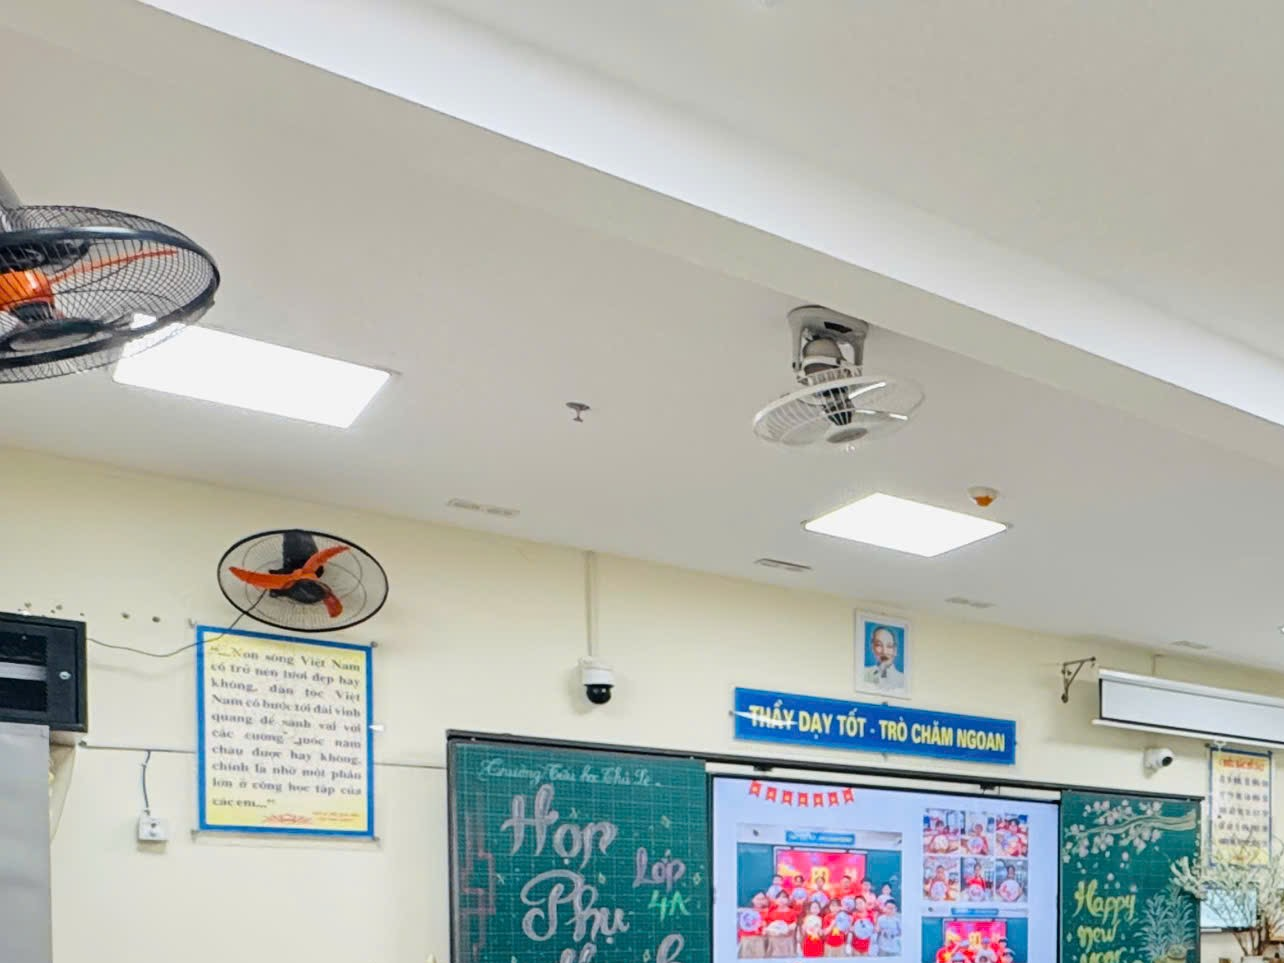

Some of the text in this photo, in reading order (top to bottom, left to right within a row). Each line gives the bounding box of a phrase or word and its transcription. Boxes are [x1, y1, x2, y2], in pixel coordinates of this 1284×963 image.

[301, 655, 325, 667] Việt
[331, 659, 360, 671] Nam
[339, 674, 360, 689] hay
[211, 694, 243, 706] Nam
[749, 698, 795, 730] THẦY
[799, 710, 832, 739] DẠY
[837, 707, 868, 738] TỐT
[879, 716, 908, 742] TRÒ
[911, 720, 953, 747] CHĂM
[957, 730, 1006, 752] NGOAN
[290, 749, 312, 762] hay
[500, 783, 618, 870] Họp
[632, 847, 687, 892] Lớp
[519, 869, 630, 944] Phụ
[1072, 879, 1136, 925] Happy
[1077, 920, 1120, 953] new
